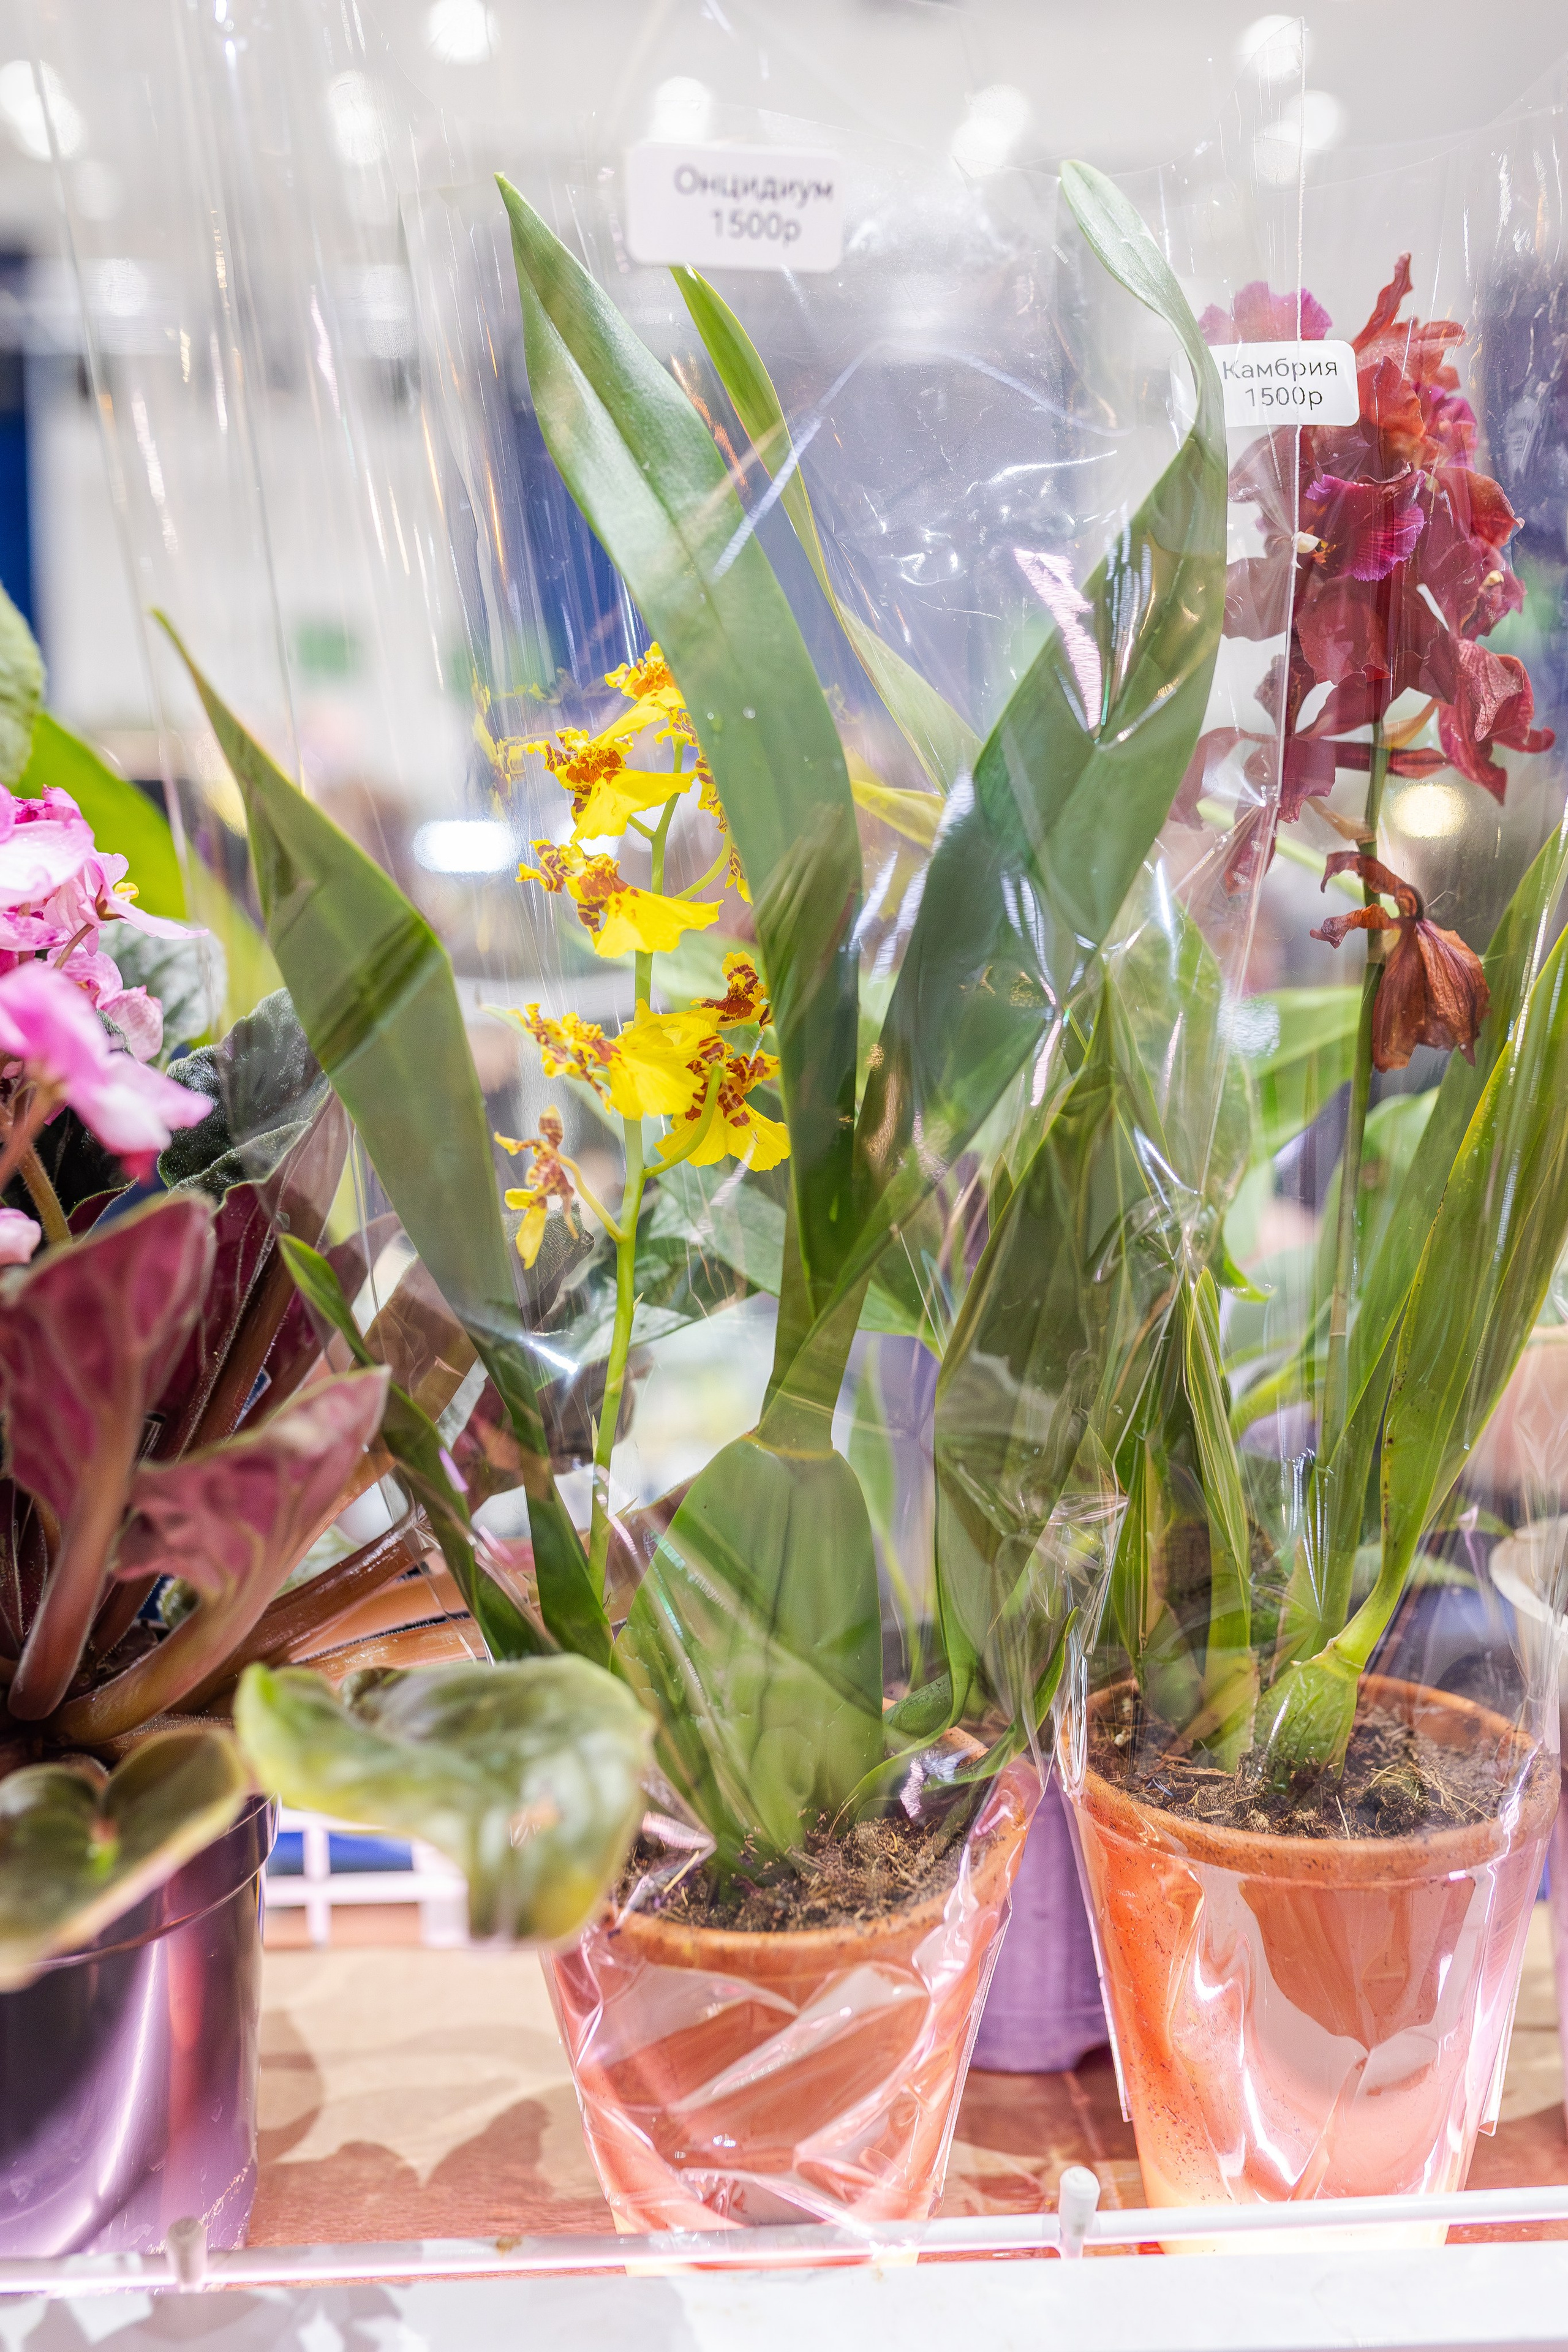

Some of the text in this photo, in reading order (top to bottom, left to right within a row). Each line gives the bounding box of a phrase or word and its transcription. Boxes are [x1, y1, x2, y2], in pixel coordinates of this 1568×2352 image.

[674, 164, 834, 209] Онцидиум
[712, 209, 802, 248] 1500р
[1223, 358, 1337, 382] Камбрия
[1245, 386, 1322, 410] 1500р
